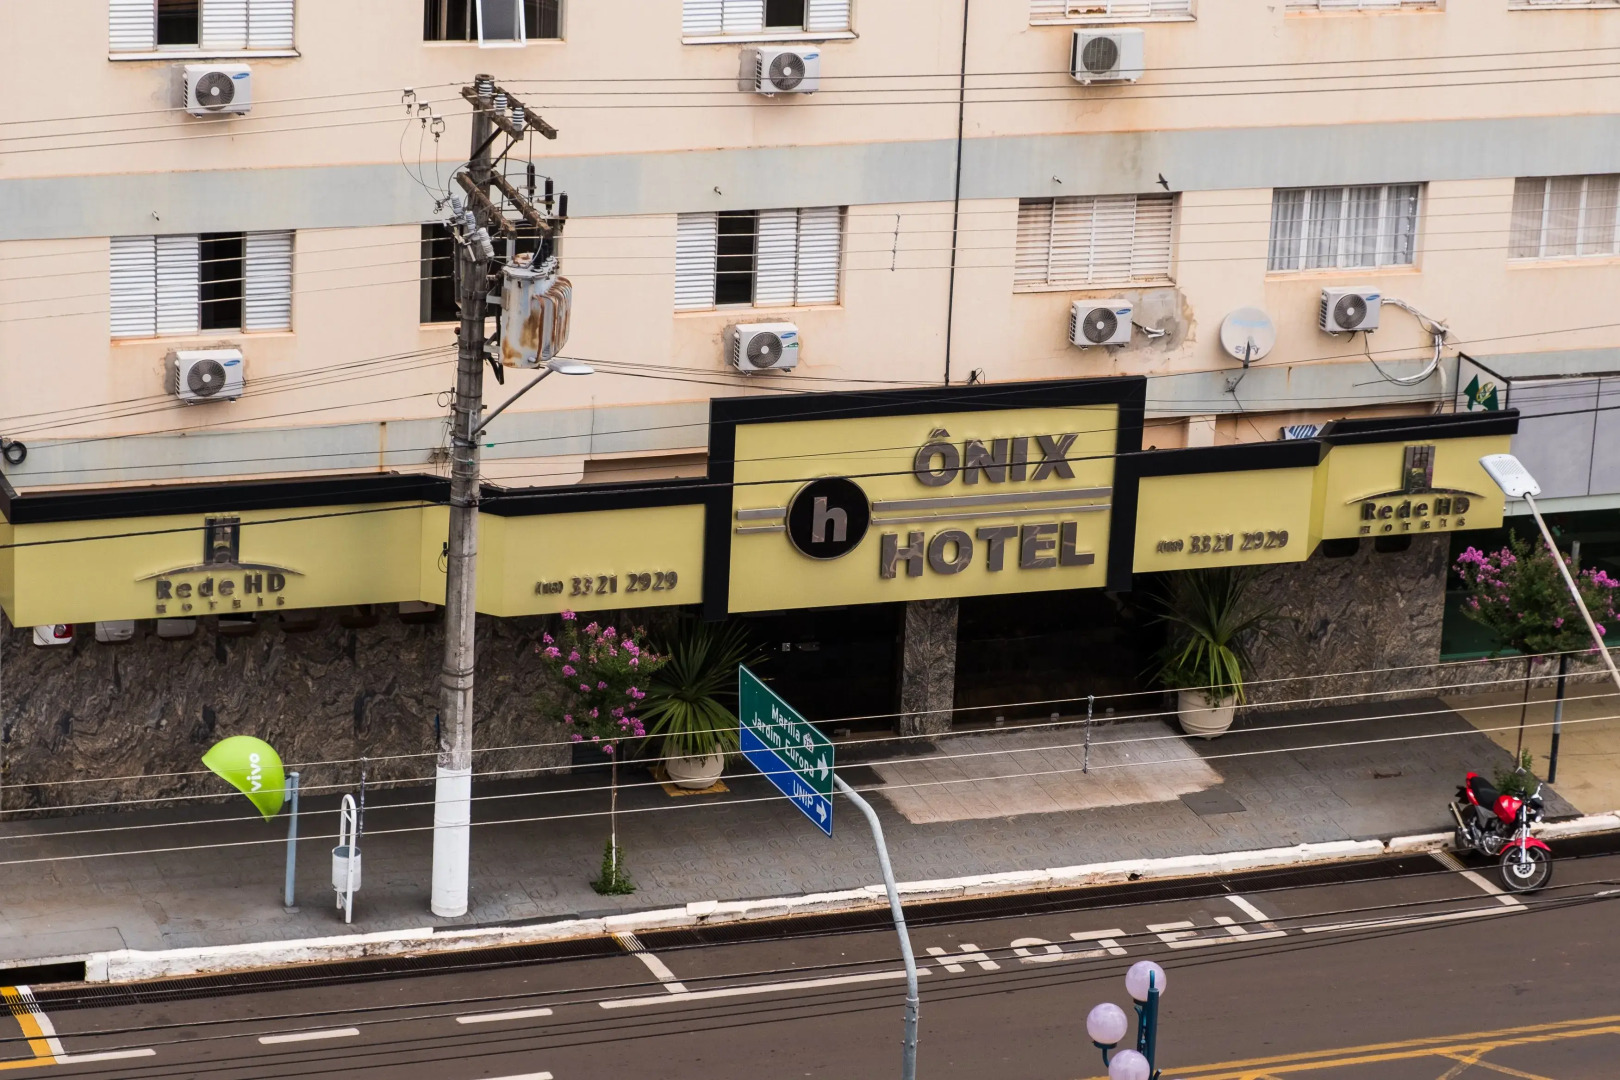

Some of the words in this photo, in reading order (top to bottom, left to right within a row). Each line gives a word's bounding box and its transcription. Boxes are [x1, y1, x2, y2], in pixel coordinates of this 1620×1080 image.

[914, 427, 1079, 487] ÔNIX
[811, 496, 848, 544] h
[1188, 533, 1234, 554] 3321
[1240, 530, 1289, 551] 2929
[880, 521, 1095, 580] HOTEL
[570, 574, 618, 596] 3321
[625, 571, 678, 593] 2929
[752, 711, 781, 748] Jardim
[785, 738, 814, 778] Europa
[771, 703, 800, 743] Marília
[246, 752, 262, 792] vivo
[792, 779, 814, 808] UNIP
[925, 916, 1288, 973] HOTEL
